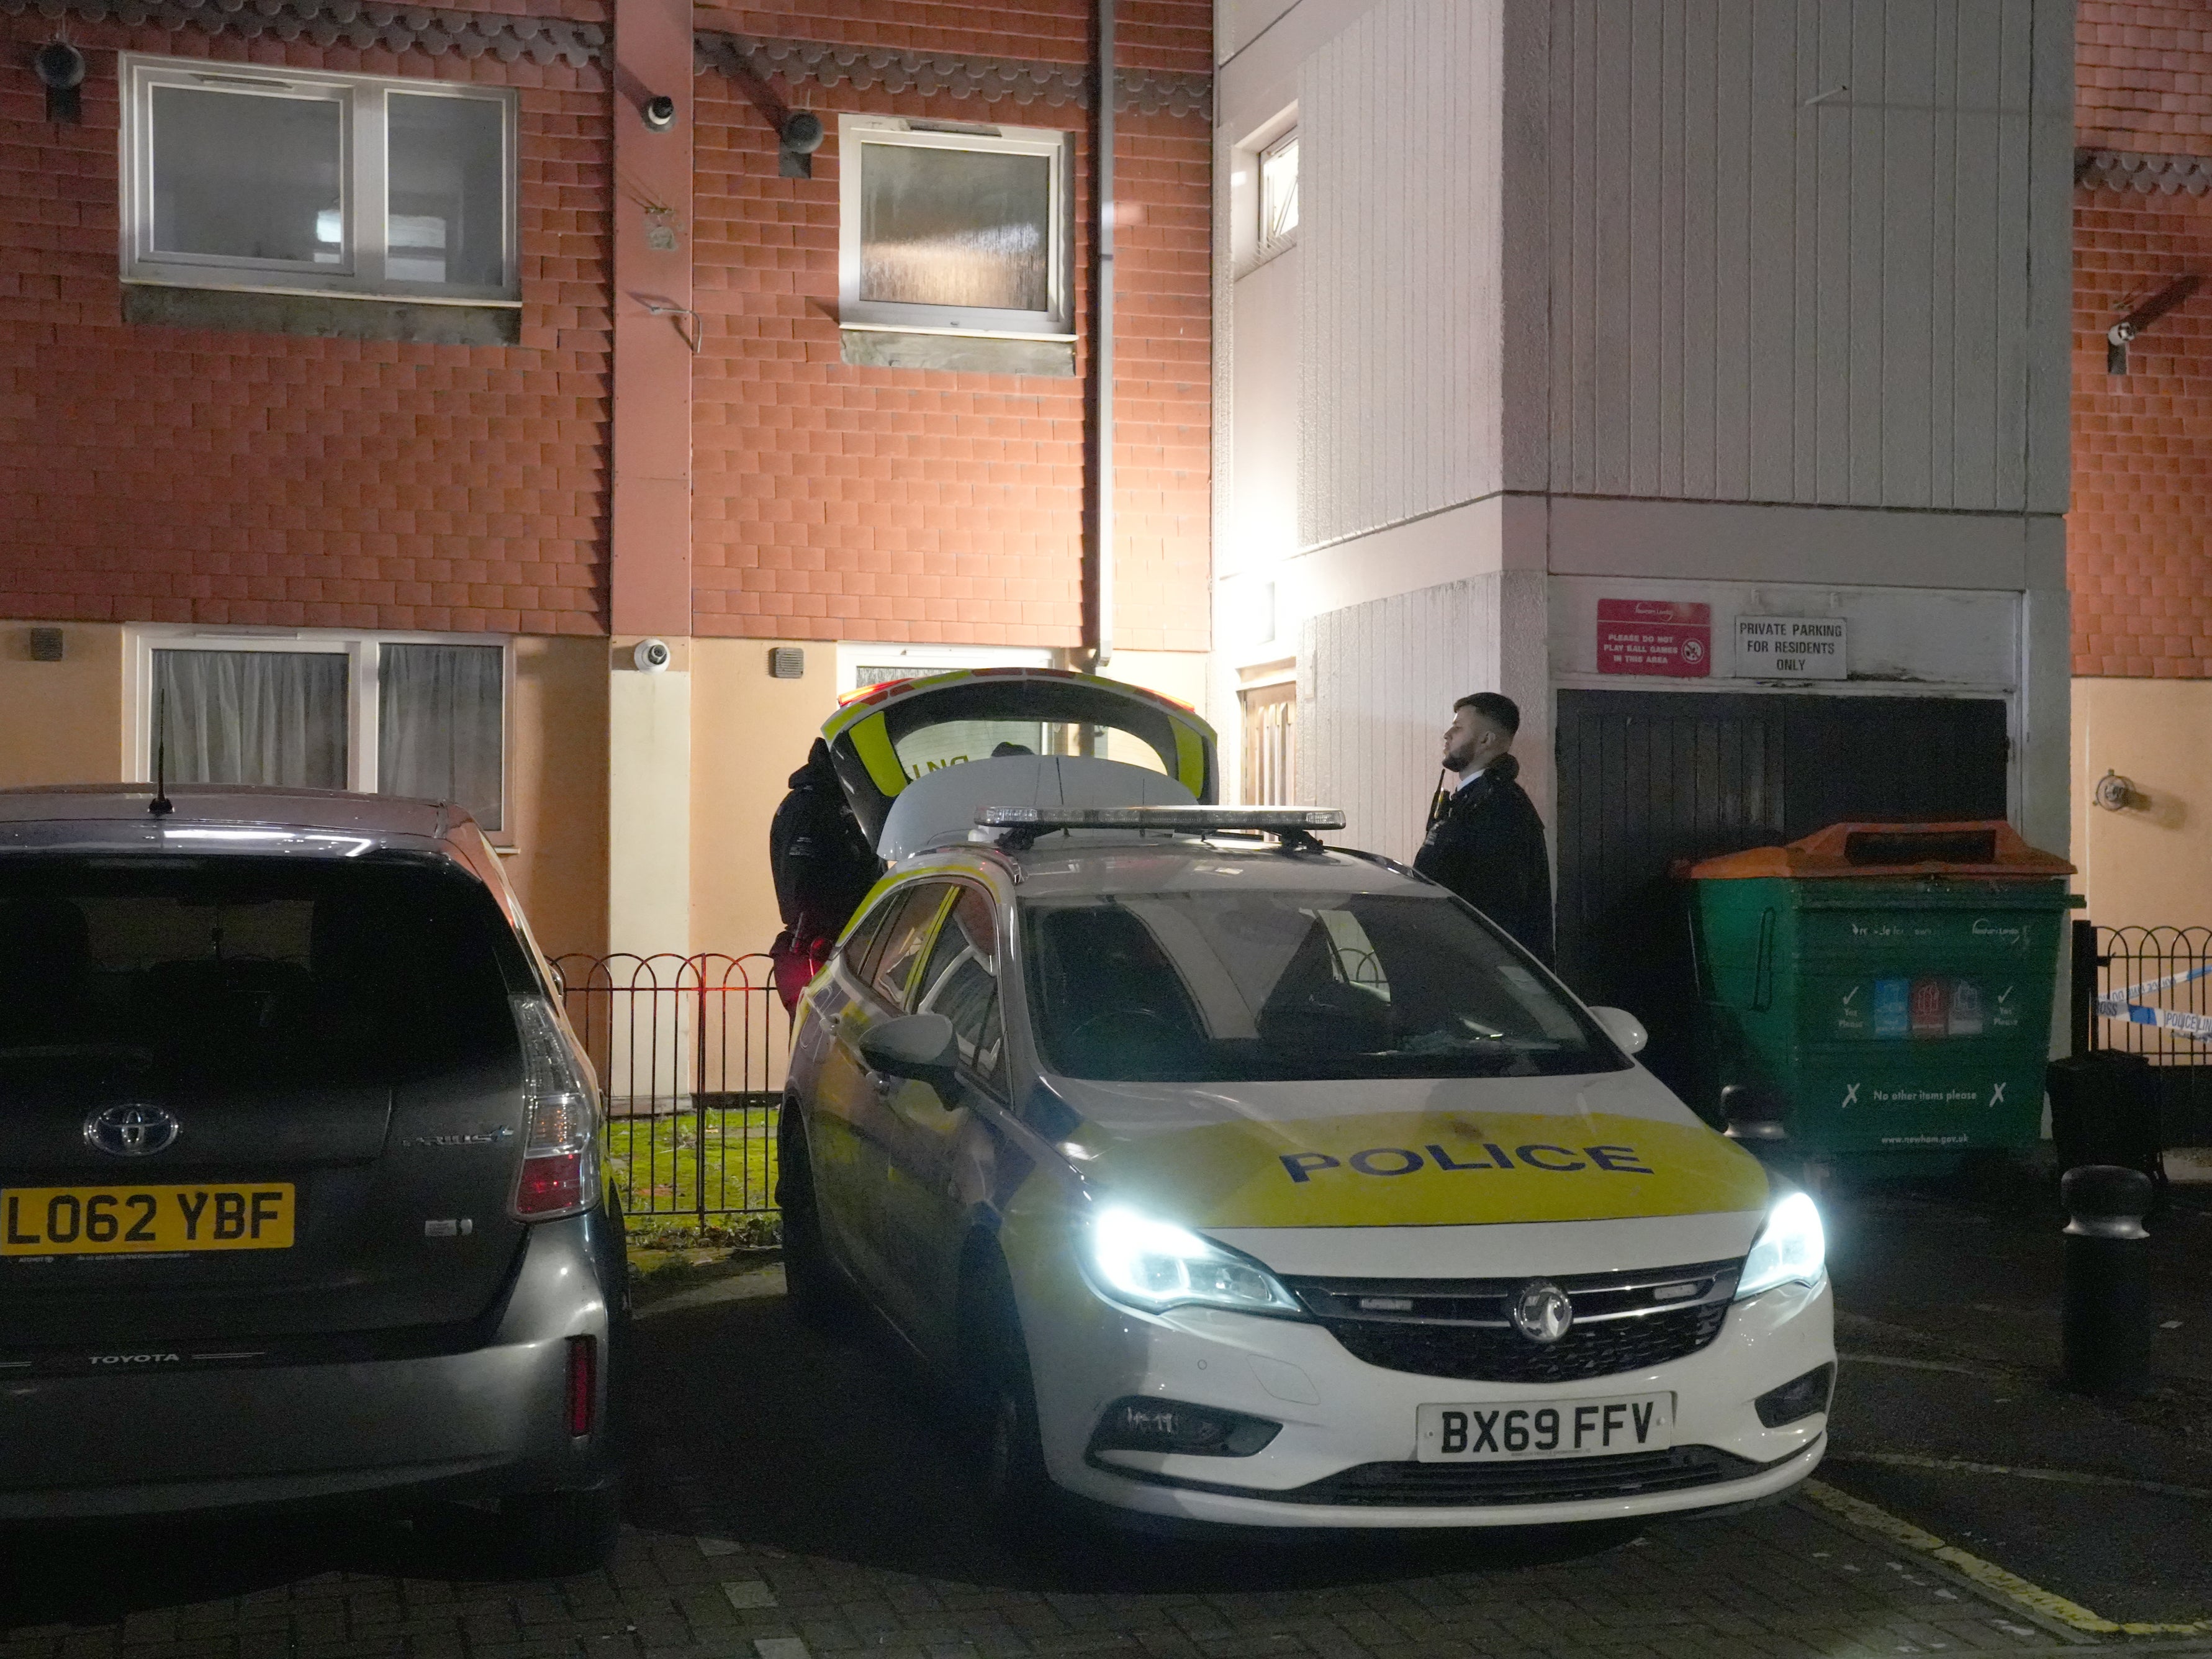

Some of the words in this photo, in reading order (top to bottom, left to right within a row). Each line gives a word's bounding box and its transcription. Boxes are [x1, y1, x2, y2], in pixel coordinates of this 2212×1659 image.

[1740, 623, 1787, 635] PRIVATE
[1792, 625, 1842, 637] PARKING
[1608, 634, 1640, 642] PLEASE
[1650, 646, 1678, 654] GAMES
[1747, 640, 1768, 653] FOR
[1775, 641, 1835, 654] RESIDENTS
[1646, 656, 1668, 664] AREA
[1776, 659, 1806, 671] ONLY
[2166, 1012, 2196, 1029] POLICE
[1873, 1090, 1889, 1101] No
[1892, 1090, 1917, 1100] other
[1919, 1090, 1944, 1100] items
[1946, 1090, 1977, 1102] please
[1881, 1134, 1968, 1145] www.newham.gov.uk
[1278, 1143, 1655, 1183] POLICE
[7, 1194, 157, 1244] LO62
[177, 1191, 283, 1241] YBF
[88, 1354, 180, 1364] TOYOTA
[1442, 1408, 1560, 1453] BX69
[1574, 1401, 1654, 1449] FFV
